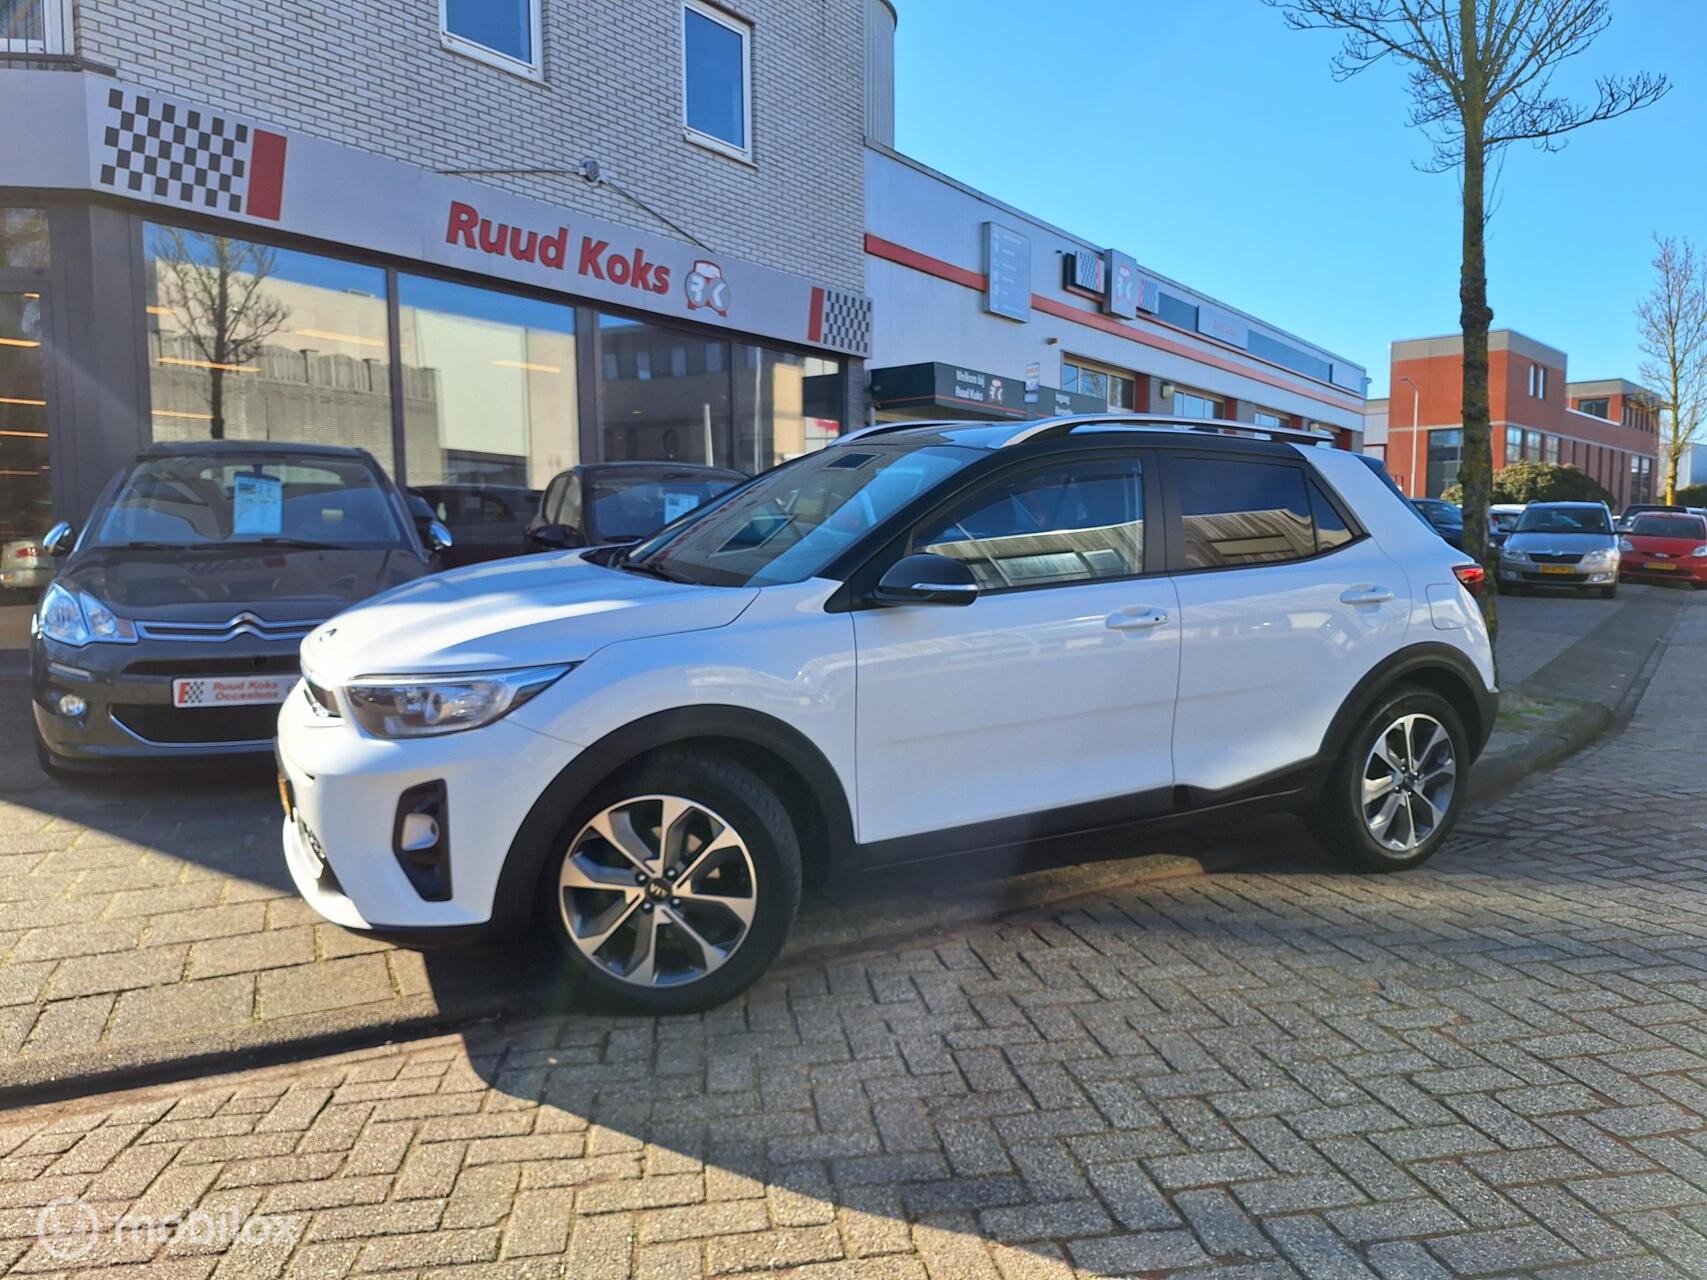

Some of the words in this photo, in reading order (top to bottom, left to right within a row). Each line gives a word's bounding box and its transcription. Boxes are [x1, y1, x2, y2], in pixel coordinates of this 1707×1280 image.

[446, 200, 569, 270] Ruud
[578, 236, 672, 295] Koks
[213, 681, 245, 691] Ruud
[247, 681, 278, 689] Koks
[215, 690, 278, 700] Occasions
